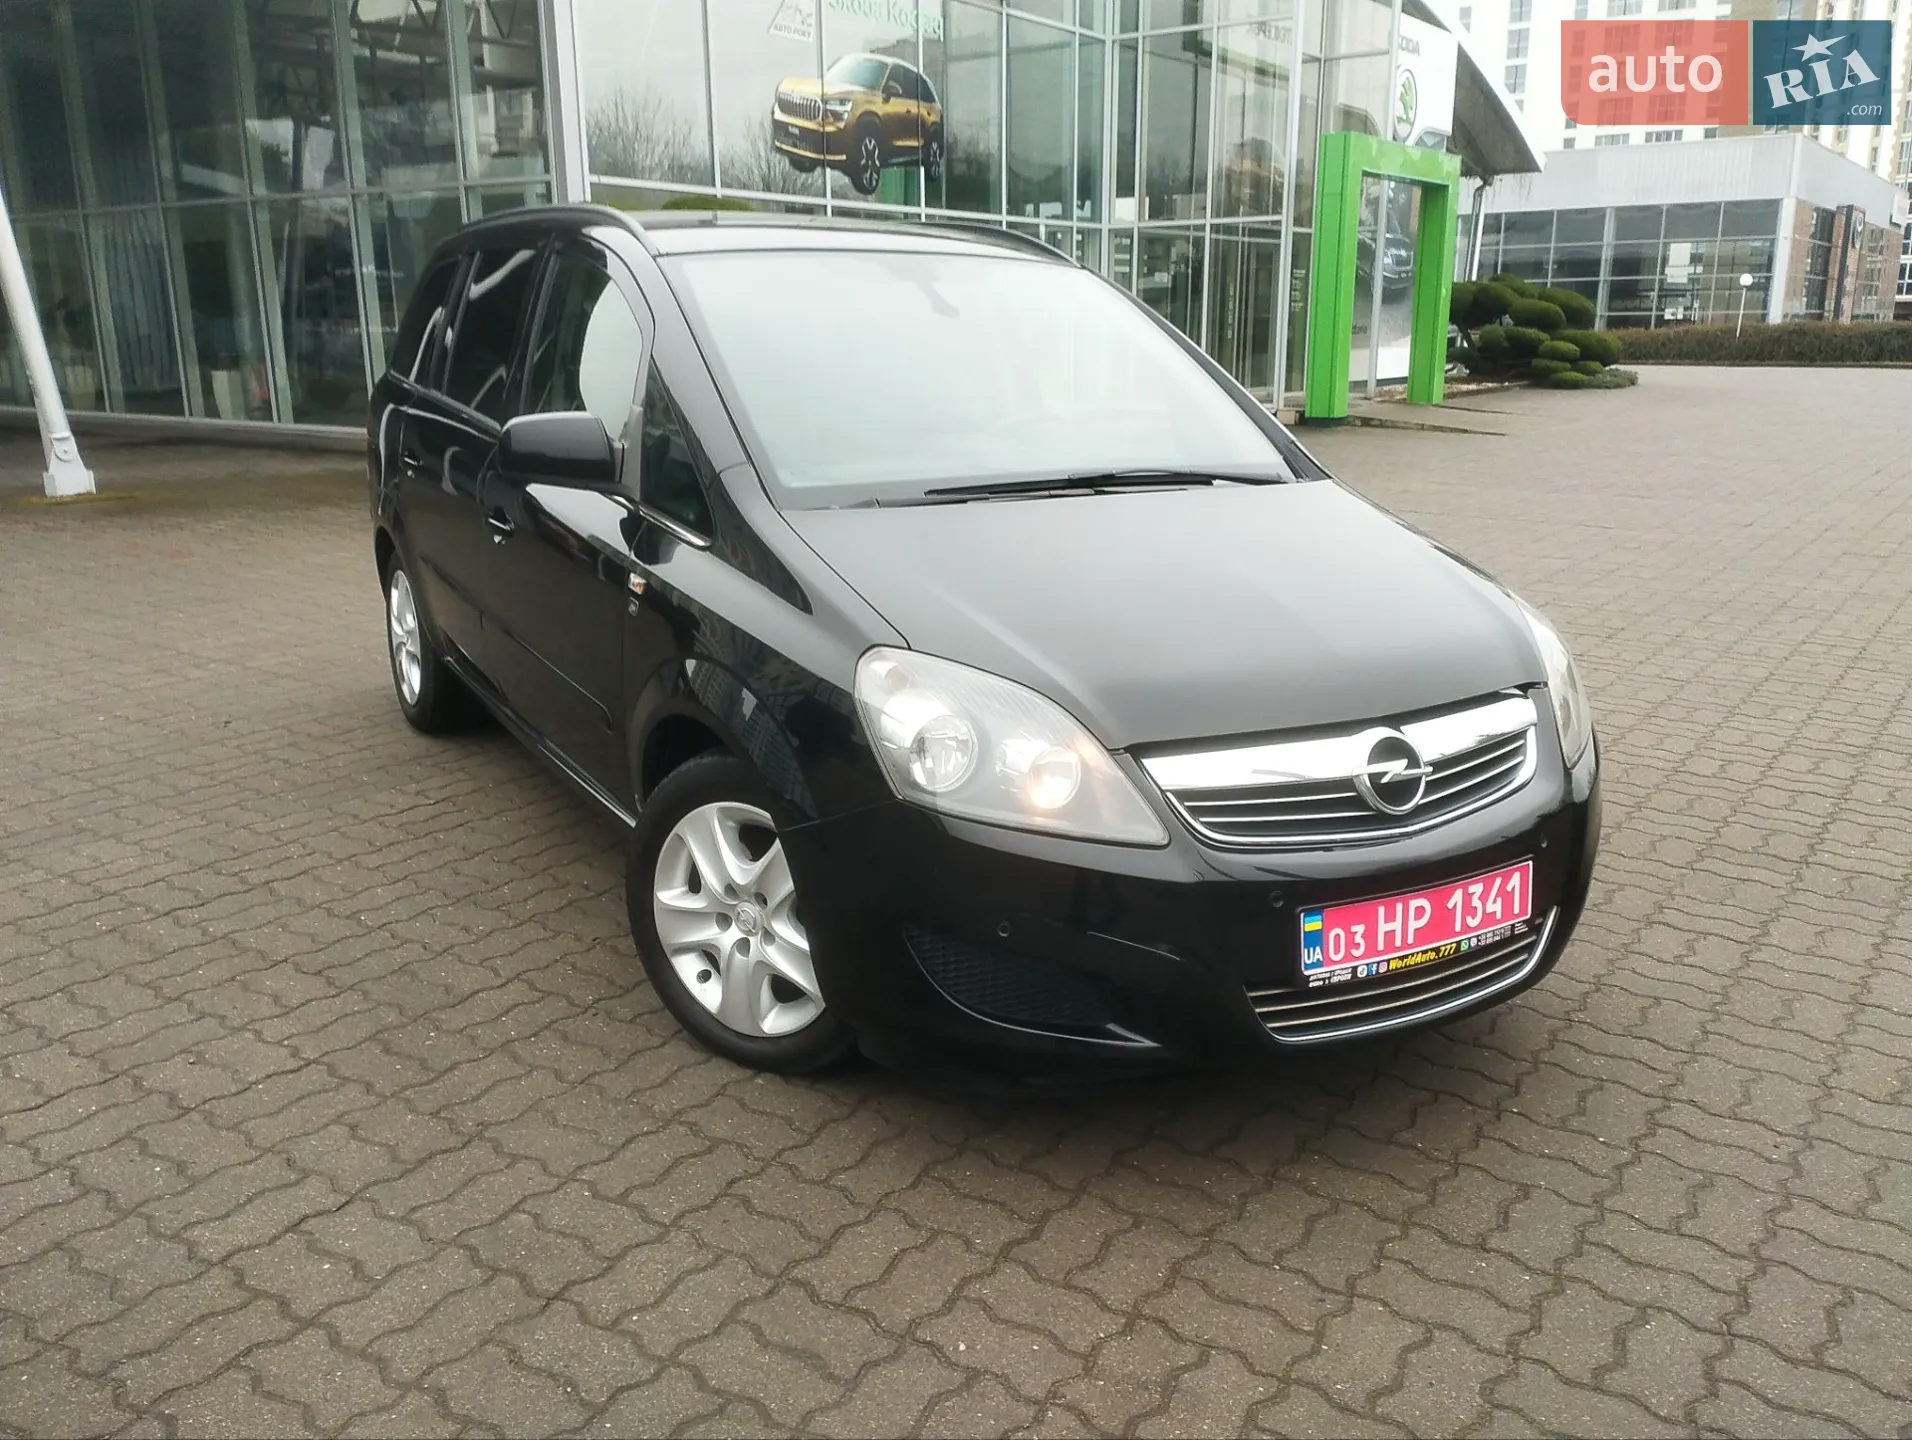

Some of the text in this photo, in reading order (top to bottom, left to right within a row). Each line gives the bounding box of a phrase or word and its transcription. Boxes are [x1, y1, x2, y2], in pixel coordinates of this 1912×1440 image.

[1304, 945, 1323, 964] UA
[1328, 923, 1366, 962] 03
[1376, 897, 1432, 952] HP
[1446, 871, 1521, 933] 1341
